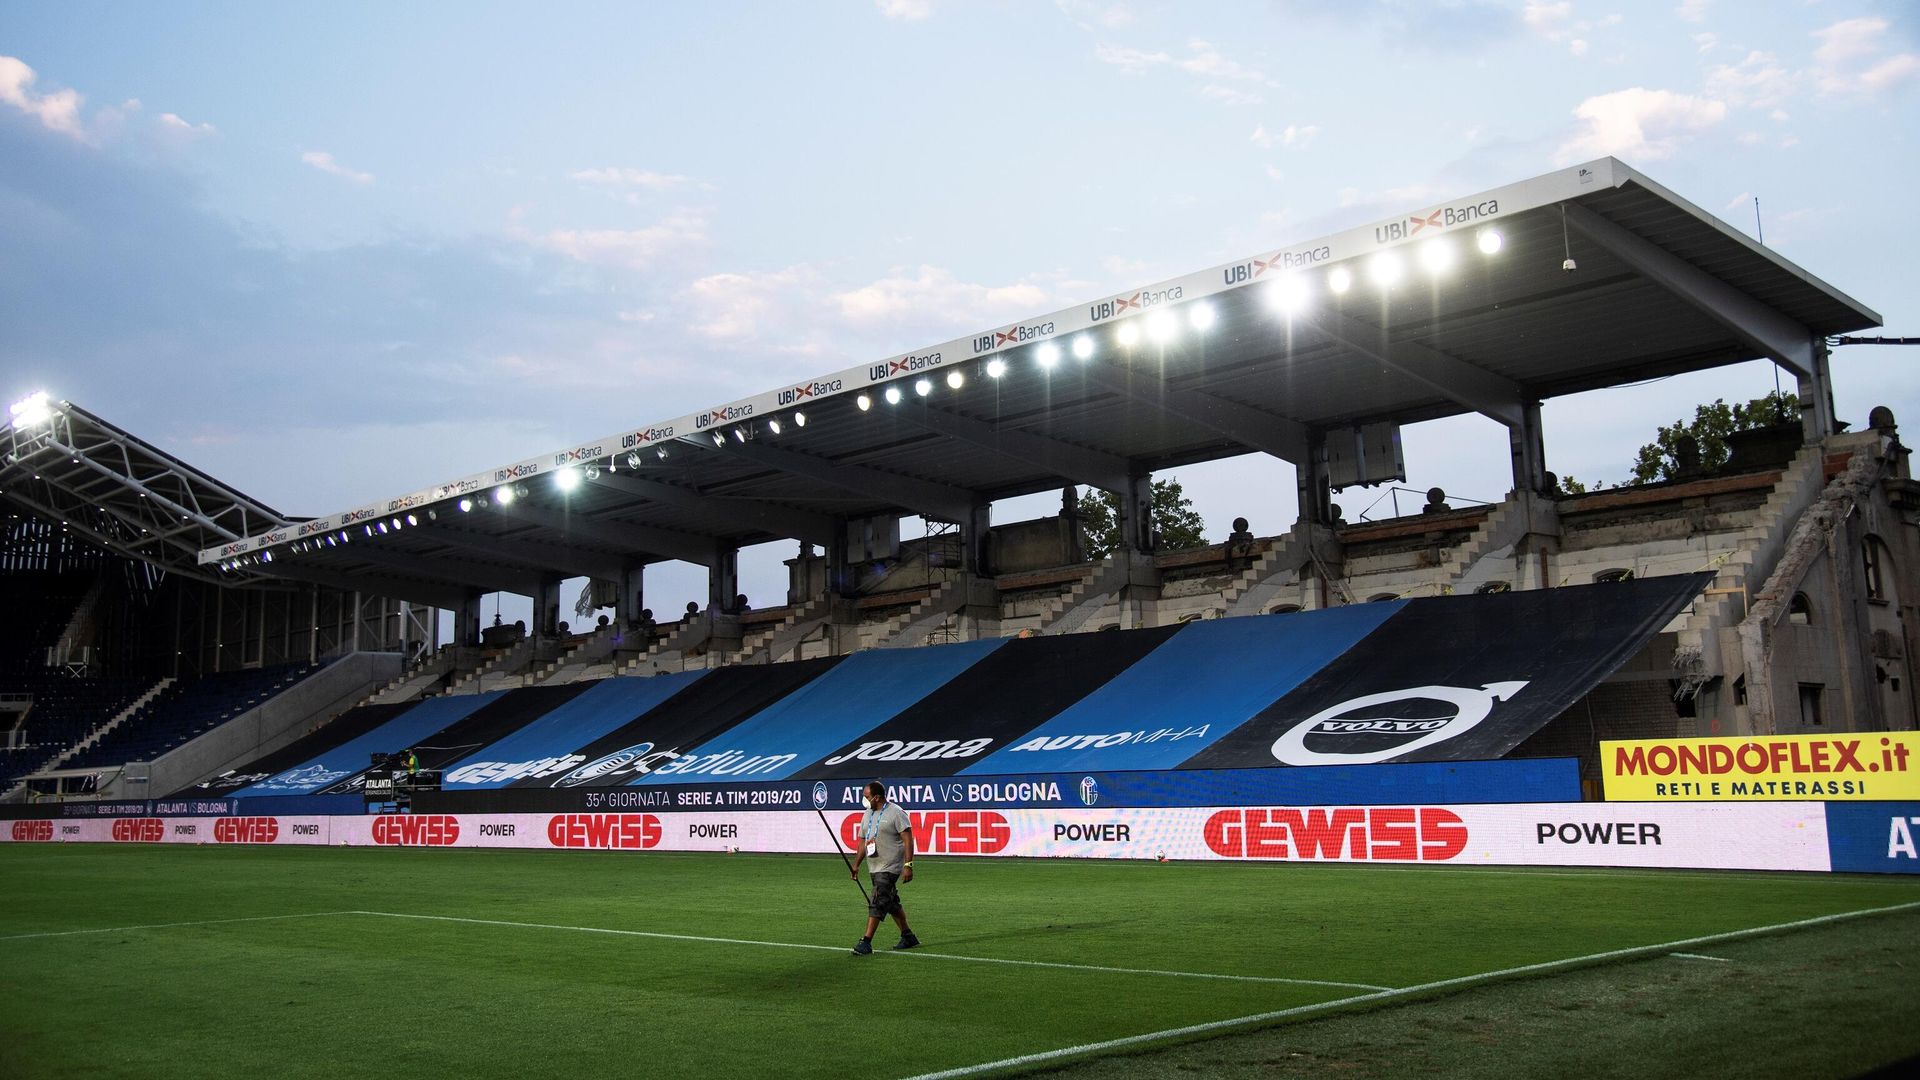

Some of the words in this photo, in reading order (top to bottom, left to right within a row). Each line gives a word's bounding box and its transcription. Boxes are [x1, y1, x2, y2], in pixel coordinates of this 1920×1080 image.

[1376, 220, 1408, 244] UBI
[1444, 200, 1498, 226] Banca
[1224, 262, 1252, 285] UBI
[1284, 246, 1330, 270] Banca
[1091, 301, 1114, 321] UBI
[1142, 286, 1182, 308] Banca
[973, 334, 995, 353] UBI
[1019, 321, 1054, 341] Banca
[870, 363, 889, 381] UBI
[910, 352, 942, 370] Banca
[778, 390, 795, 406] UBI
[814, 379, 842, 396] Banca
[696, 415, 711, 428] UBI
[728, 404, 752, 420] Banca
[622, 435, 636, 448] UBI
[650, 426, 674, 441] Banca
[555, 453, 568, 466] UBI
[582, 446, 602, 460] Banca
[494, 470, 506, 482] UBI
[518, 463, 537, 476] Banca
[461, 480, 478, 491] Banca
[342, 514, 350, 524] UBI
[360, 509, 375, 520] Banca
[298, 525, 307, 535] UBI
[315, 521, 329, 531] Banca
[258, 538, 267, 546] UBI
[274, 532, 286, 541] Banca
[221, 546, 229, 556] UBI
[1322, 719, 1449, 732] VOLVO
[1008, 724, 1210, 751] AUTOMHA
[1615, 738, 1909, 776] MONDOFLEX.it
[365, 779, 391, 789] ATALANTA
[842, 785, 935, 803] ATANTA
[940, 784, 963, 803] VS
[968, 782, 1061, 802] BOLOGNA
[1656, 783, 1700, 796] RETI
[1712, 782, 1720, 795] E
[1732, 780, 1865, 795] MATERASSI
[156, 802, 187, 813] ATALANTA
[189, 802, 197, 813] VS
[198, 802, 227, 813] BOLOGNA
[609, 792, 670, 806] GIORNATA
[678, 792, 712, 805] SERIE
[715, 792, 724, 805] A
[728, 791, 748, 805] TIM
[750, 790, 801, 805] 2019/20
[98, 805, 111, 814] SERIE
[117, 805, 125, 814] TIM
[125, 805, 143, 814] 2019/20
[12, 821, 53, 840] GEWISS
[62, 826, 80, 834] POWER
[112, 819, 164, 841] GEWISS
[175, 825, 196, 835] POWER
[214, 817, 279, 842] GEWISS
[292, 825, 319, 835] POWER
[372, 816, 459, 845] GEWISS
[480, 824, 515, 836] POWER
[548, 814, 662, 848] GEWISS
[689, 824, 738, 838] POWER
[1054, 824, 1130, 841] POWER
[1204, 808, 1468, 860] GEWISS
[1536, 822, 1662, 845] POWER
